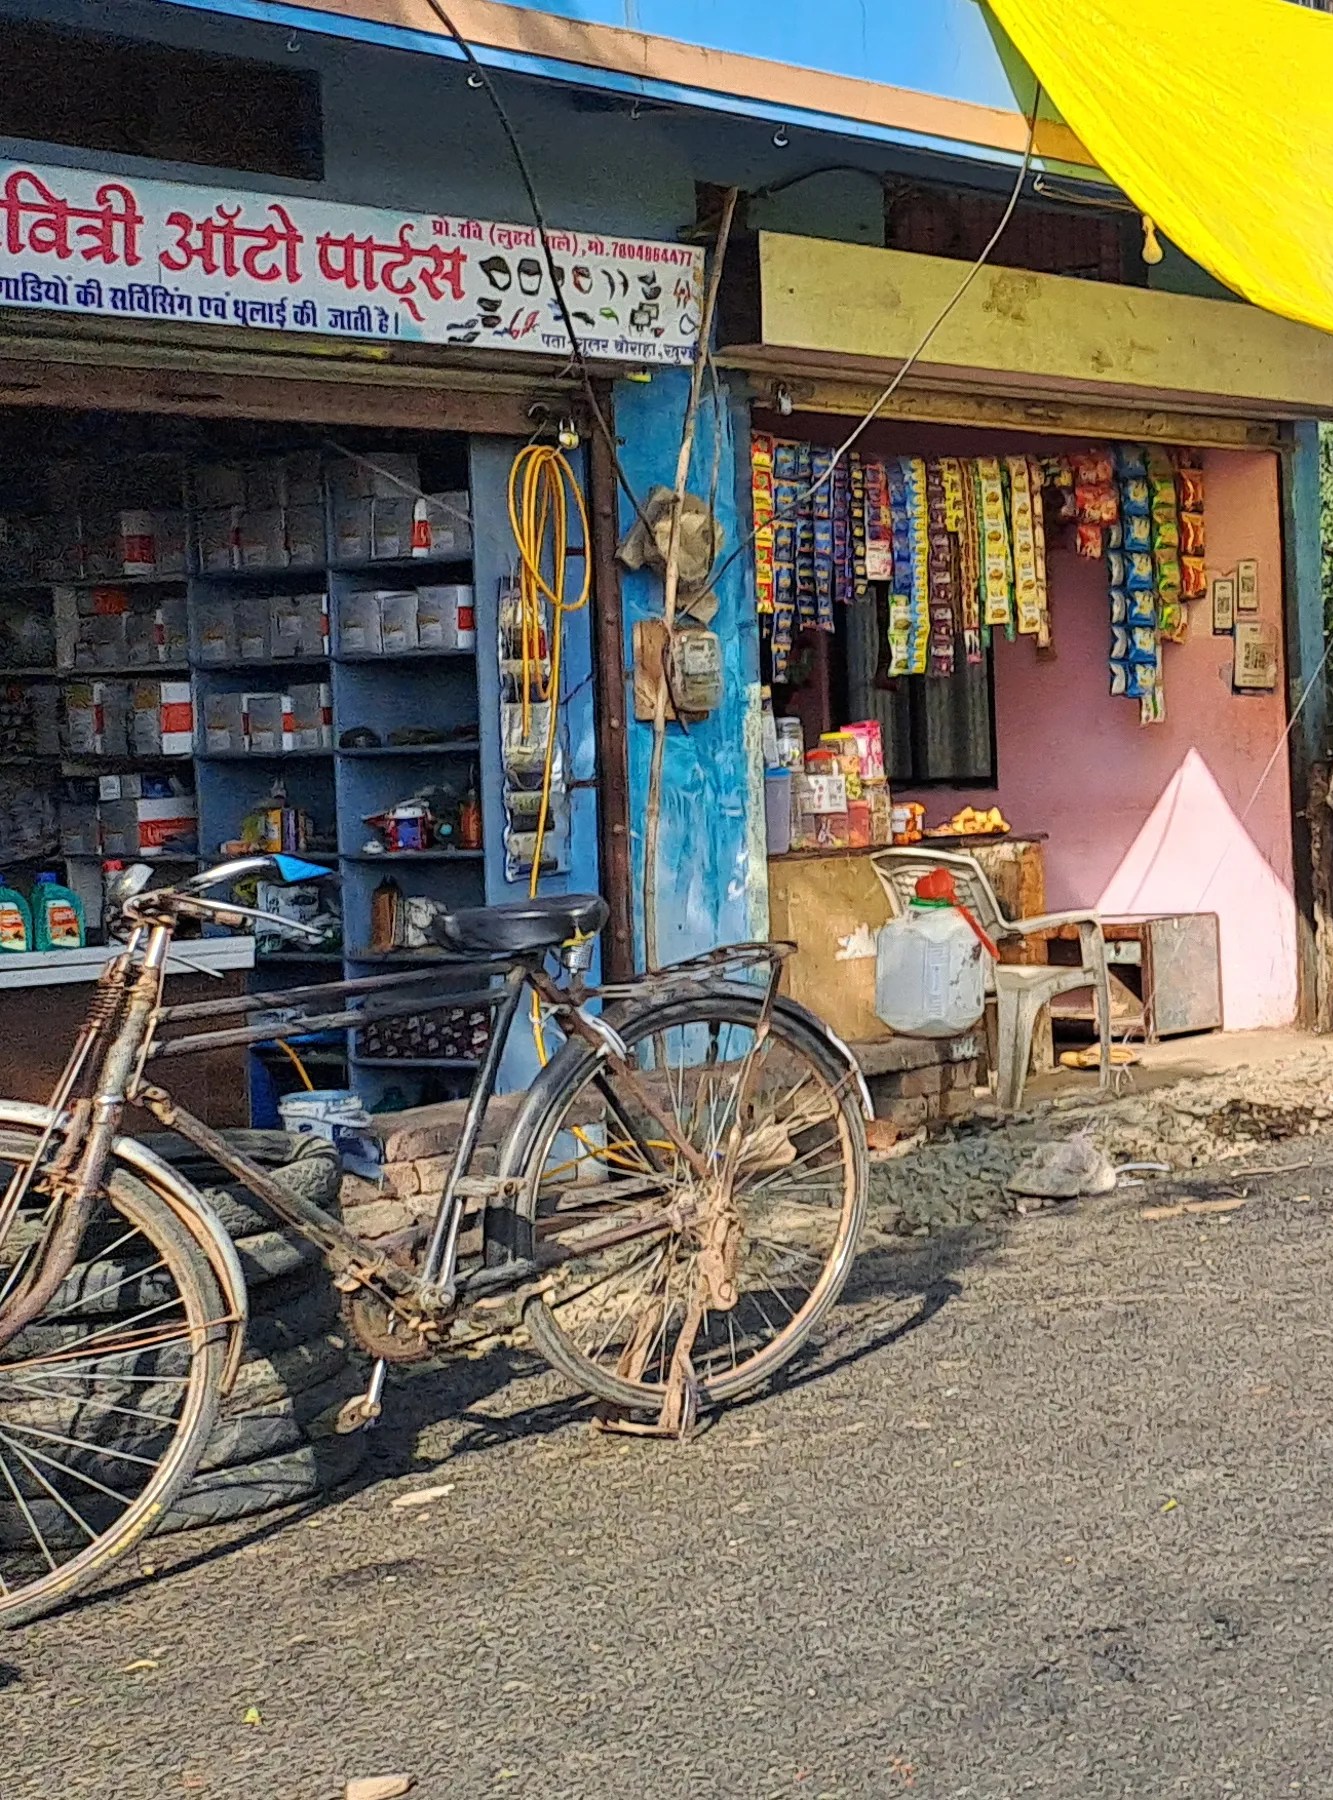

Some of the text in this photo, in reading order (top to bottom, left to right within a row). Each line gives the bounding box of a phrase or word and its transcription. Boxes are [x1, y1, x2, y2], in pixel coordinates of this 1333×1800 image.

[0, 171, 468, 322] वित्री ऑटो पार्ट्स
[75, 277, 103, 309] की
[198, 291, 229, 320] एवं
[292, 299, 318, 328] की
[327, 304, 373, 333] जाती
